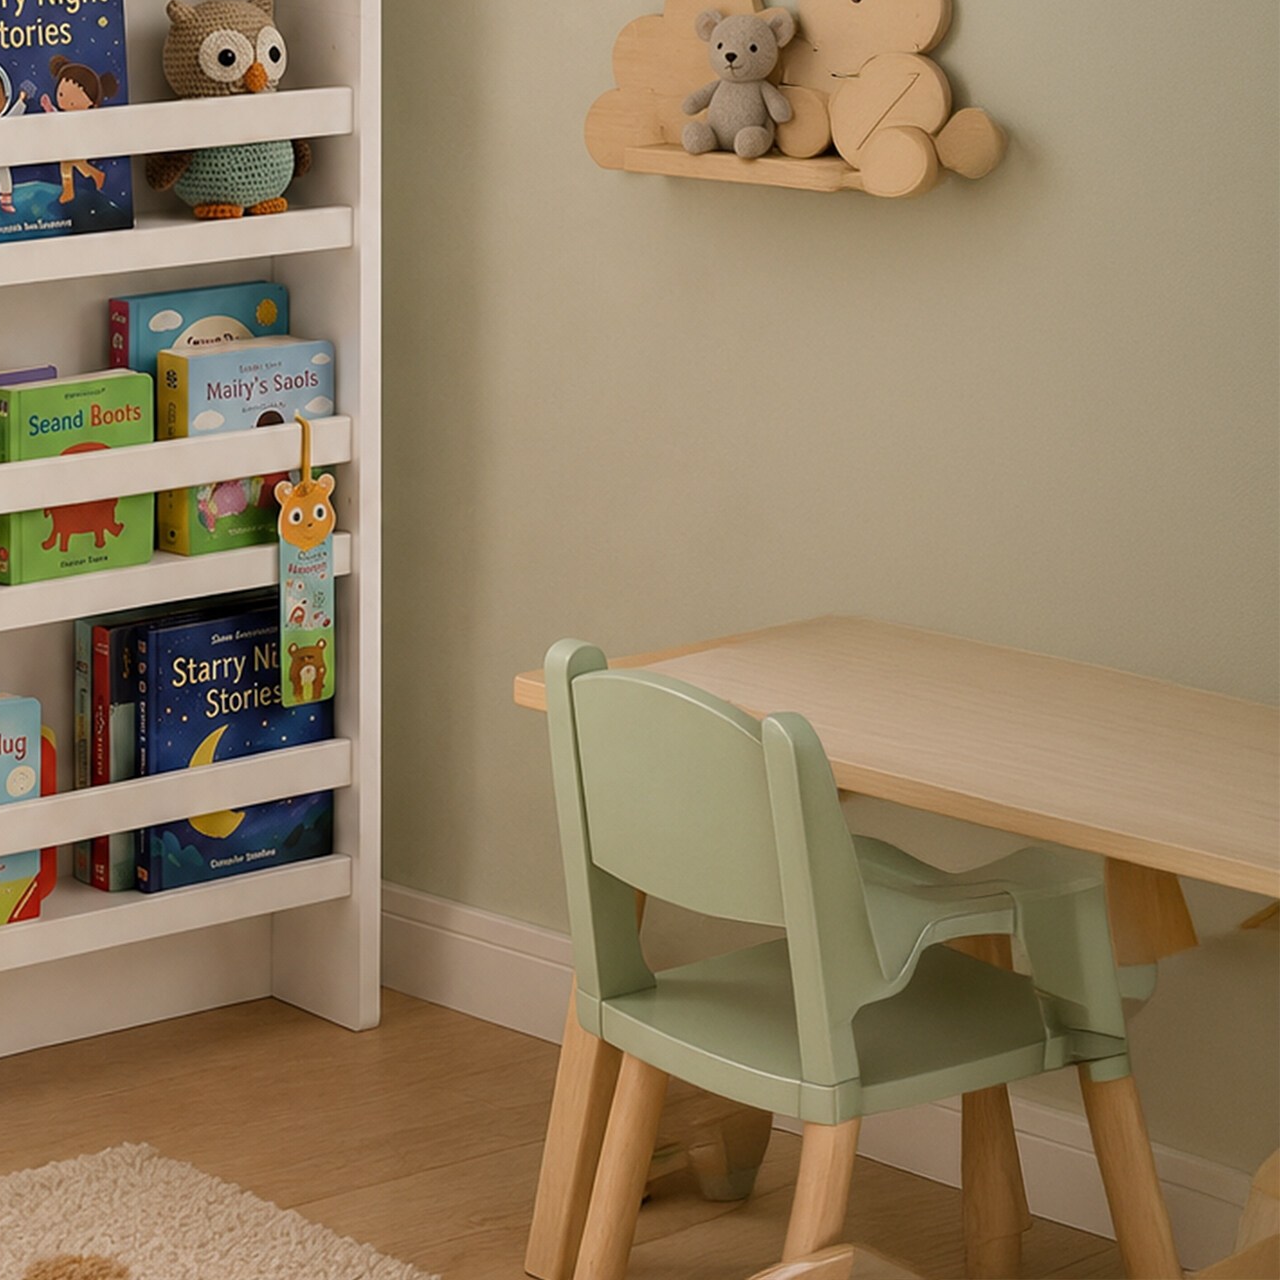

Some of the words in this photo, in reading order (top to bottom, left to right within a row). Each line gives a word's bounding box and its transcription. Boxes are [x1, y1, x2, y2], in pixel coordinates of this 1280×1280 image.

[28, 409, 83, 436] Seand
[90, 404, 141, 427] Boots
[172, 656, 246, 687] Starry
[254, 643, 279, 671] Ni
[206, 682, 281, 718] Stories
